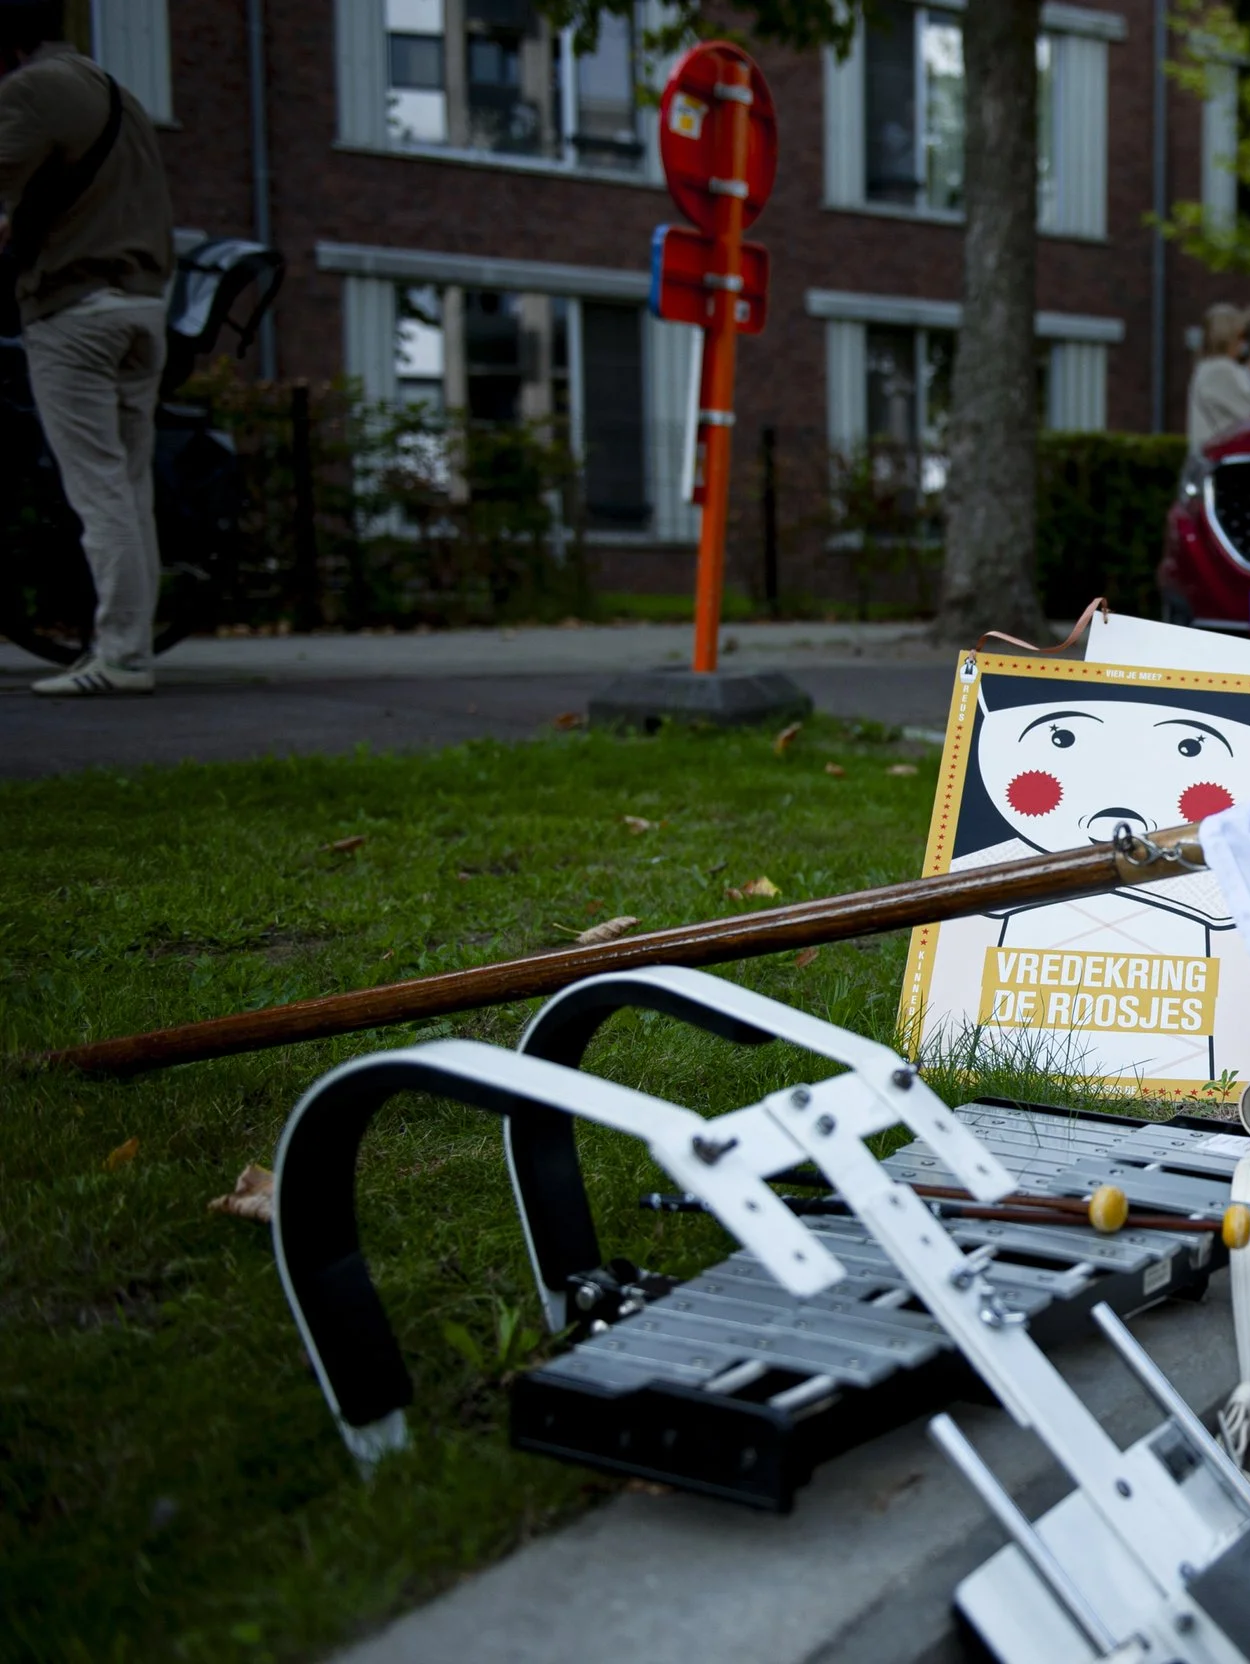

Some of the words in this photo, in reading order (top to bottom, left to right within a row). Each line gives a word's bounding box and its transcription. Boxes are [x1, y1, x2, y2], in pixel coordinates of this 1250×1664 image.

[1106, 669, 1124, 679] VIER
[1126, 671, 1136, 680] JE
[1139, 672, 1162, 681] MEE?
[959, 684, 969, 721] REUS
[997, 952, 1207, 992] VREDEKRING
[991, 989, 1037, 1023] DE
[1047, 992, 1202, 1031] ROOSJES
